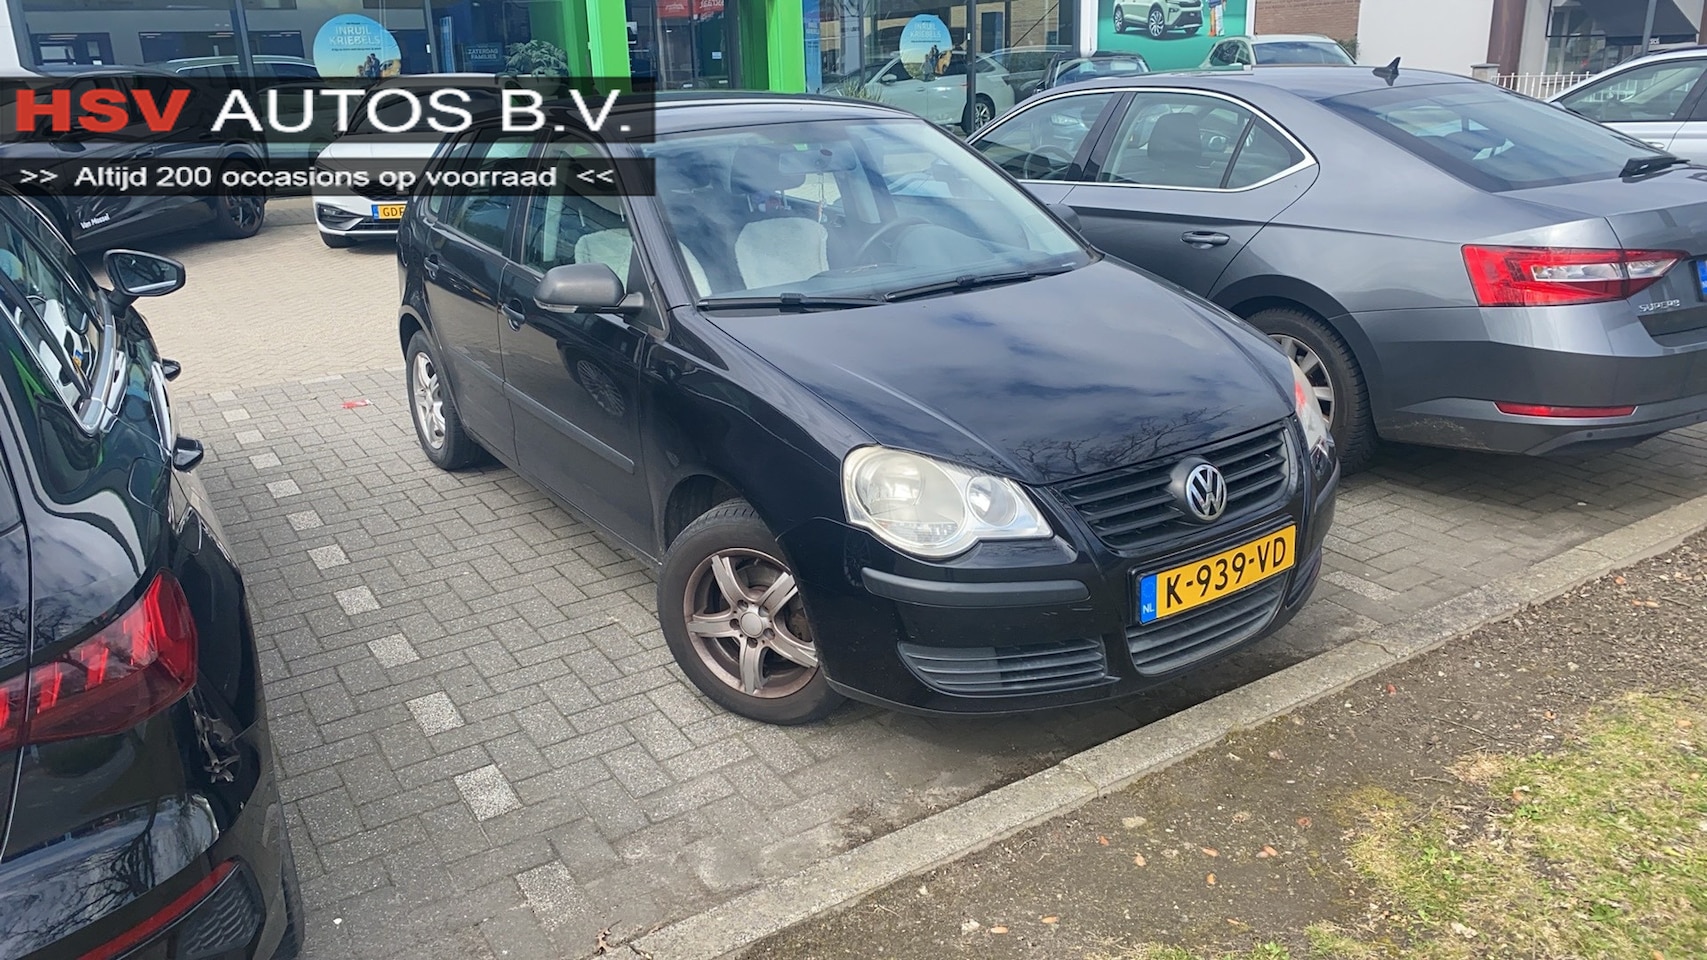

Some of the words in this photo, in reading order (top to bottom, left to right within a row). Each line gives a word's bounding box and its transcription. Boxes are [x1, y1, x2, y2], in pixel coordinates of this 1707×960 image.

[335, 26, 371, 35] INRUIL
[329, 35, 381, 45] KRIEBELS
[1639, 299, 1680, 312] SUPERB
[1166, 536, 1286, 609] K-939-VD
[1142, 604, 1155, 613] NL
